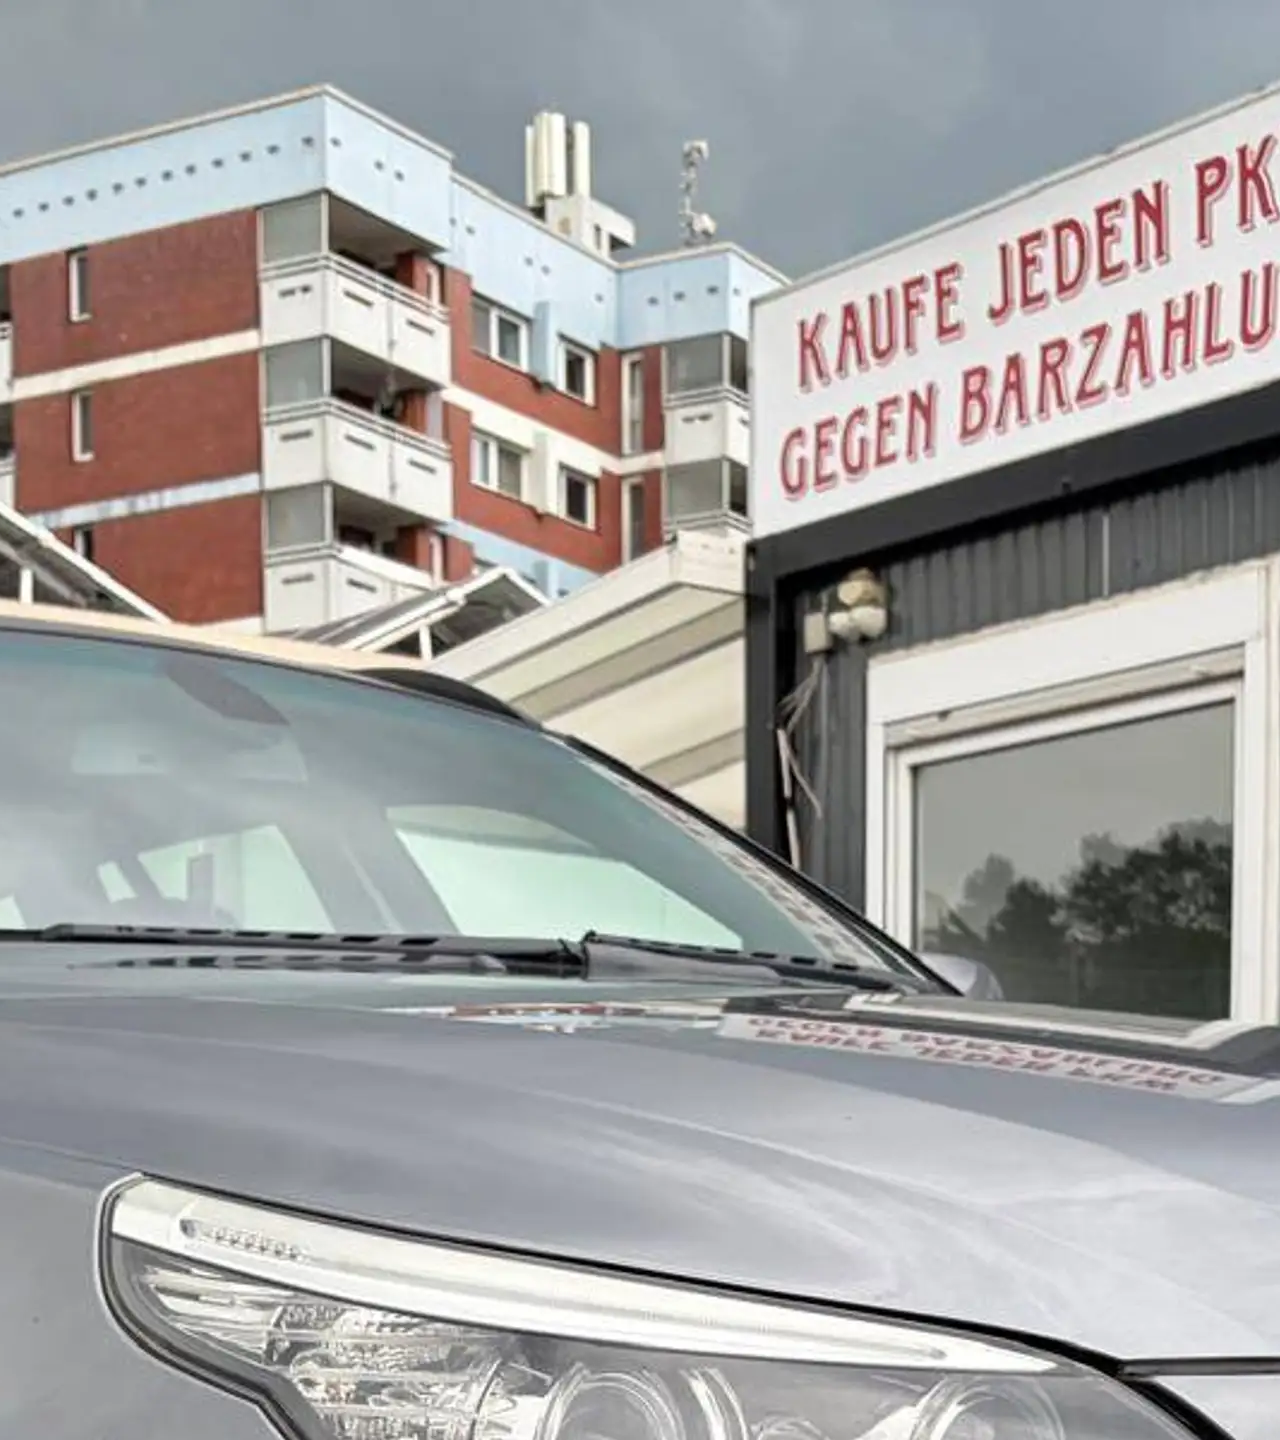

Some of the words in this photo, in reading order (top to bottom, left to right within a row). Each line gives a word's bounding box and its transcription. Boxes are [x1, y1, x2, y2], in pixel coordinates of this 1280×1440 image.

[796, 262, 965, 391] KAUFE
[989, 180, 1170, 326] JEDEN
[779, 383, 939, 499] GEGEN
